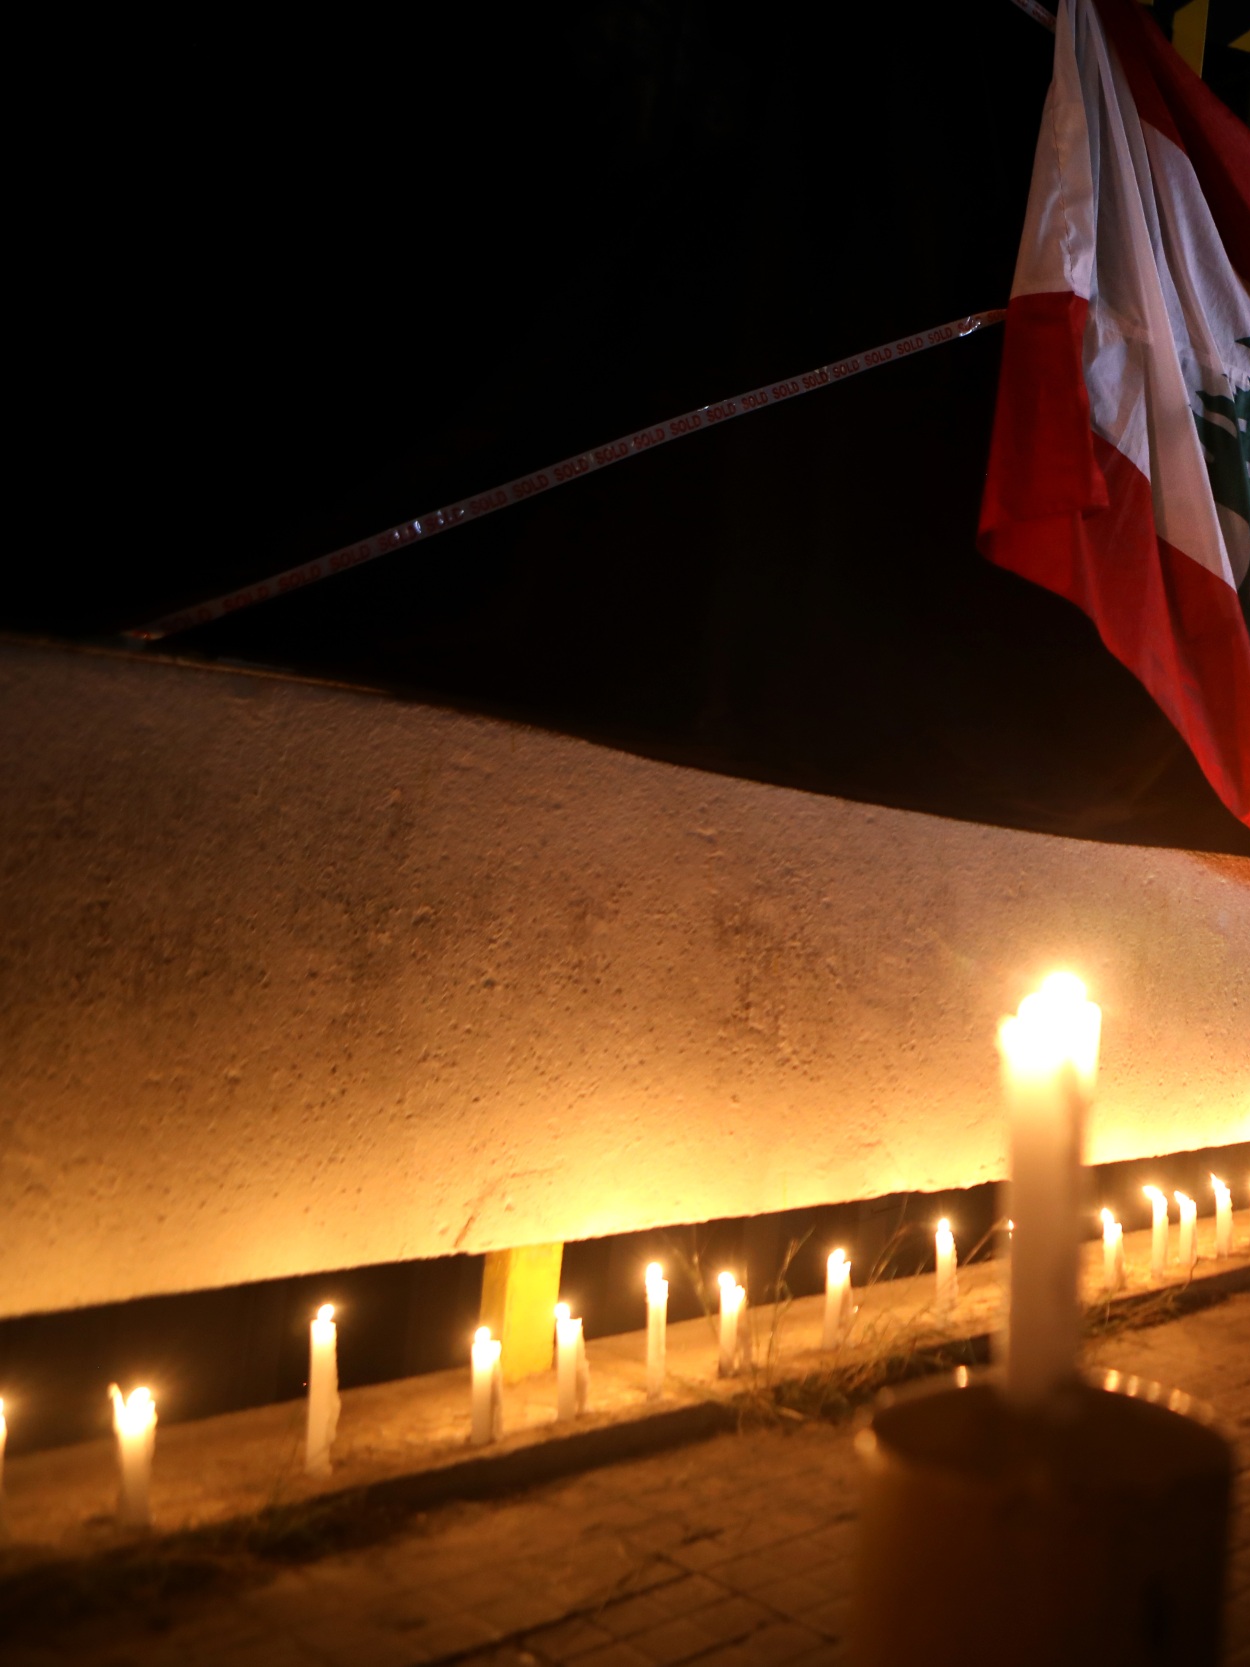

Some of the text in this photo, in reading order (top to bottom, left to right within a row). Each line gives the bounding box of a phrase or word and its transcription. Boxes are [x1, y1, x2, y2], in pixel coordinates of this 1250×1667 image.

[278, 565, 321, 592] SOLD
[330, 544, 370, 572] SOLD
[470, 491, 507, 515] SOLD
[513, 475, 549, 498] SOLD
[554, 459, 589, 482] SOLD
[595, 443, 628, 465] SOLD
[633, 428, 665, 450] SOLD
[670, 415, 701, 436] SOLD
[707, 402, 736, 423] SOLD
[741, 391, 768, 410] SOLD
[772, 381, 799, 400] SOLD
[802, 370, 829, 390] SOLD
[832, 361, 860, 379] SOLD
[864, 349, 892, 367] SOLD
[896, 337, 923, 356] SOLD
[928, 327, 953, 345] SOLD
